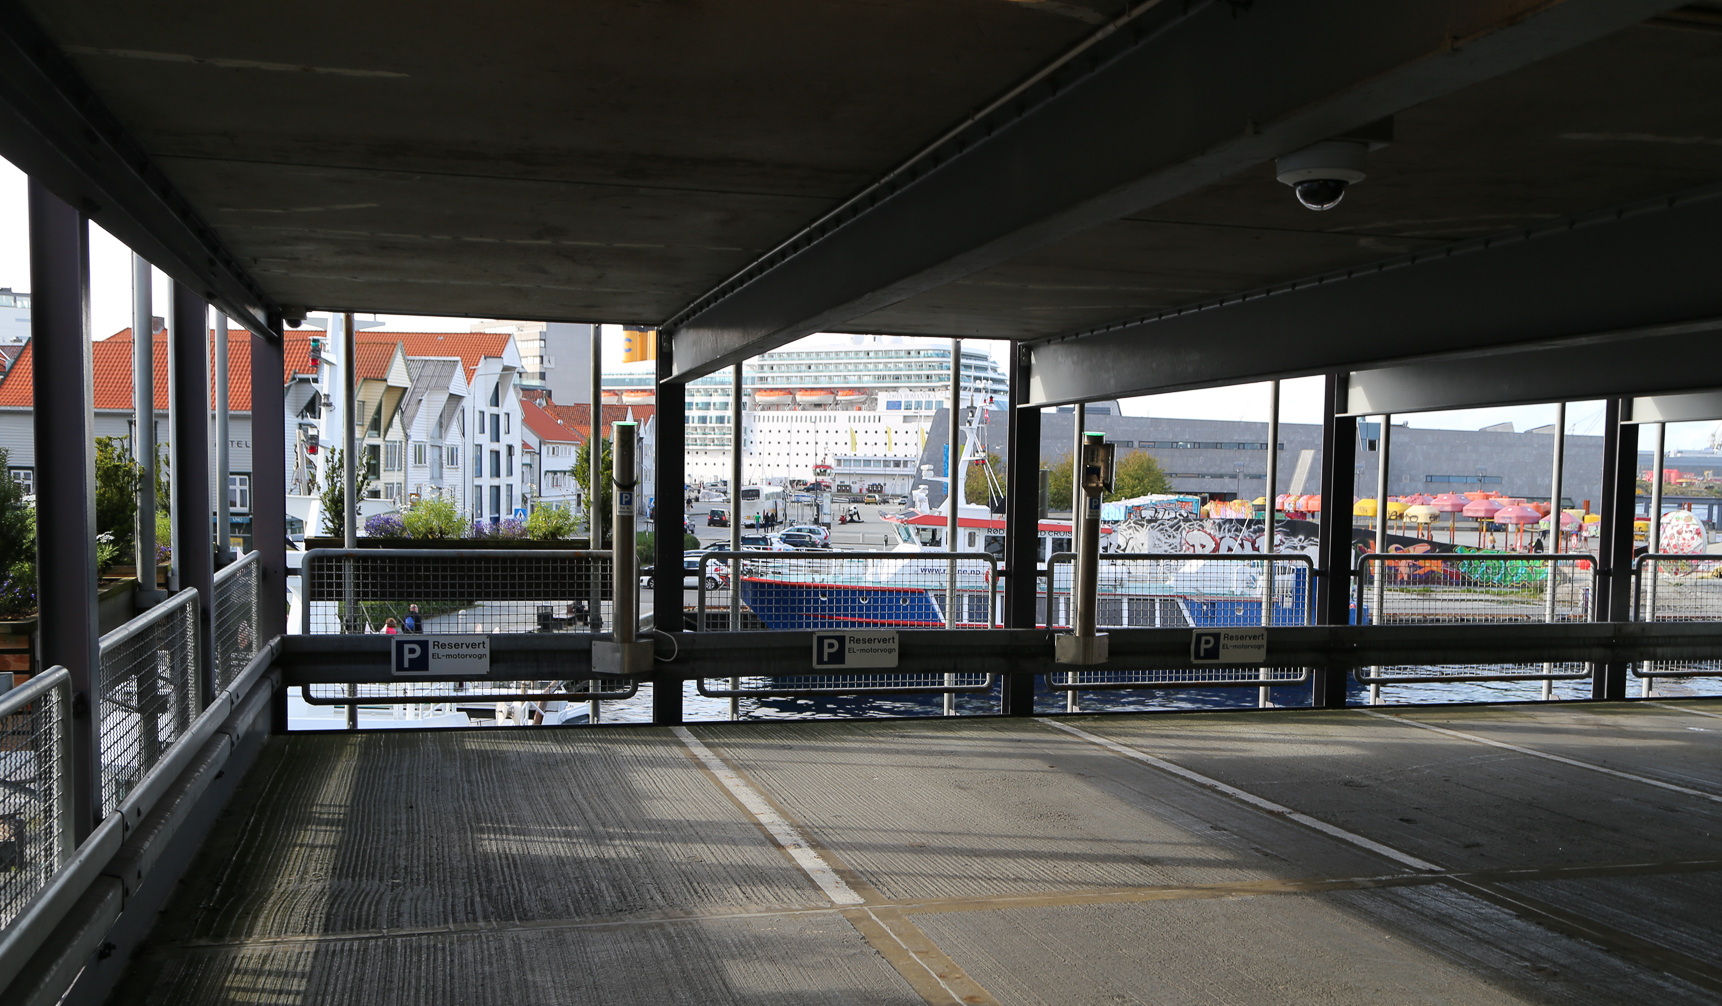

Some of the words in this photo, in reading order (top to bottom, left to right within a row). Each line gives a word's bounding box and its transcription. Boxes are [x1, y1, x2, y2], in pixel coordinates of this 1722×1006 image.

[622, 494, 630, 504] P
[920, 567, 981, 576] www.rne.no
[848, 636, 895, 644] Reservert
[1223, 633, 1264, 641] Reservert
[432, 640, 486, 650] Reservert
[823, 639, 839, 661] P
[1200, 636, 1214, 657] P
[403, 643, 421, 668] P
